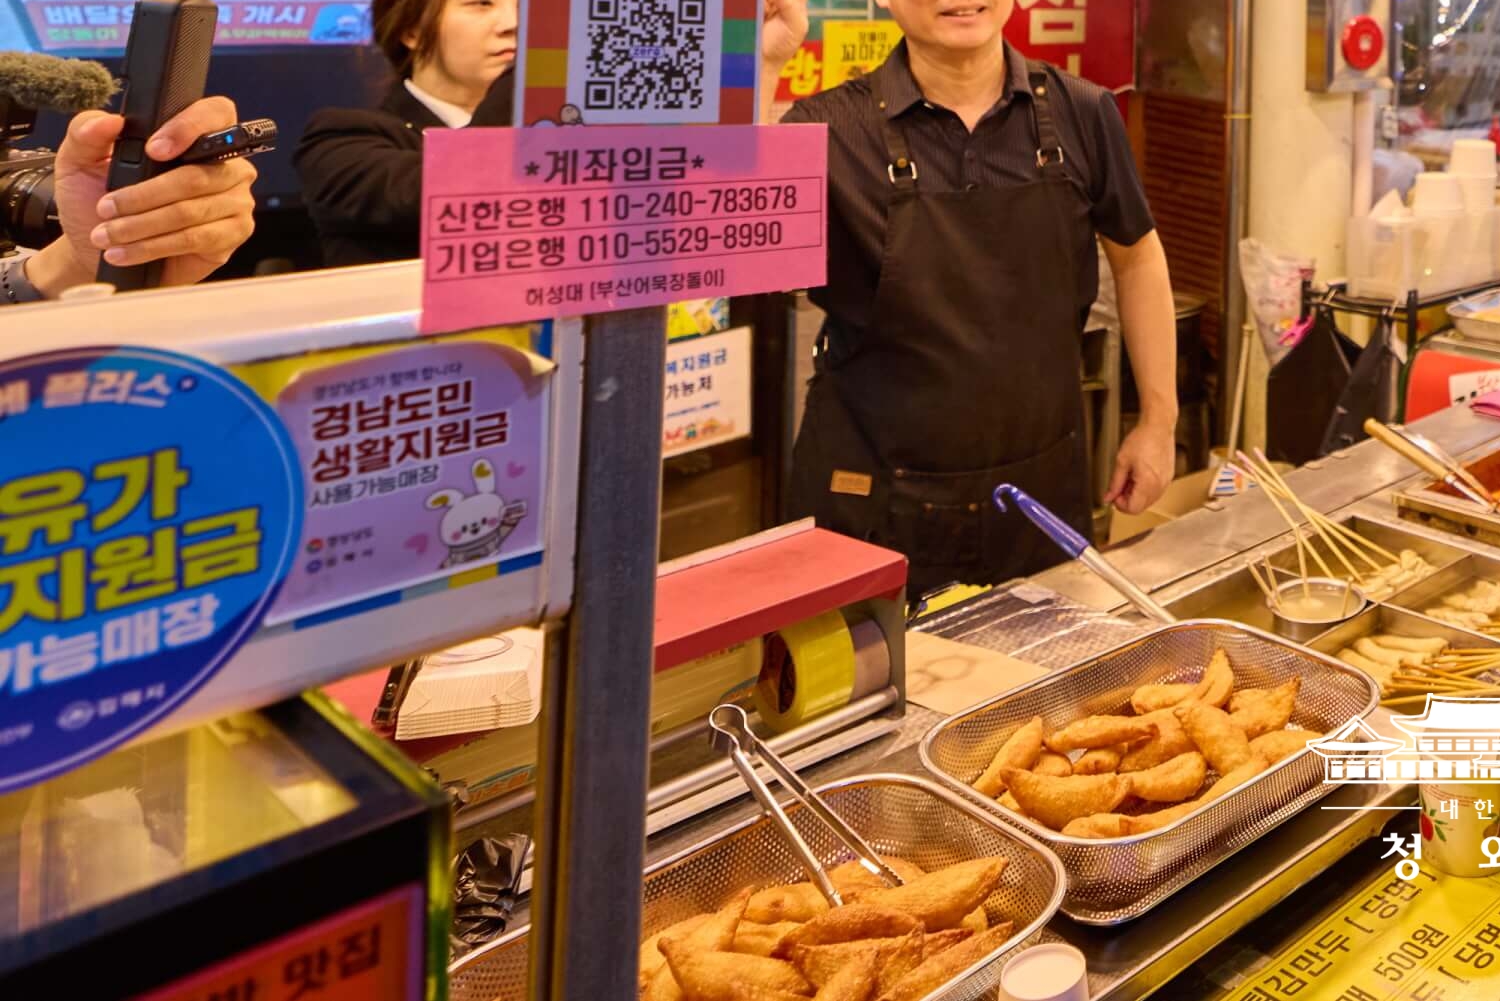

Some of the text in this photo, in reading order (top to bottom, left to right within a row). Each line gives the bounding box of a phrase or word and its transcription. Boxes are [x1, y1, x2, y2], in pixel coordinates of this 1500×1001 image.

[436, 186, 798, 234] 신한은행 110-240-783678
[436, 220, 783, 275] 기업은행 010-5529-8990
[525, 269, 725, 306] 허성대 [부산어묵장돌이]
[43, 369, 173, 408] 플러스
[312, 380, 472, 441] 경남도민
[312, 411, 509, 484] 생활지원금
[311, 465, 440, 508] 사용가능매장
[0, 507, 262, 637] 지원금
[1374, 923, 1450, 982] 500원
